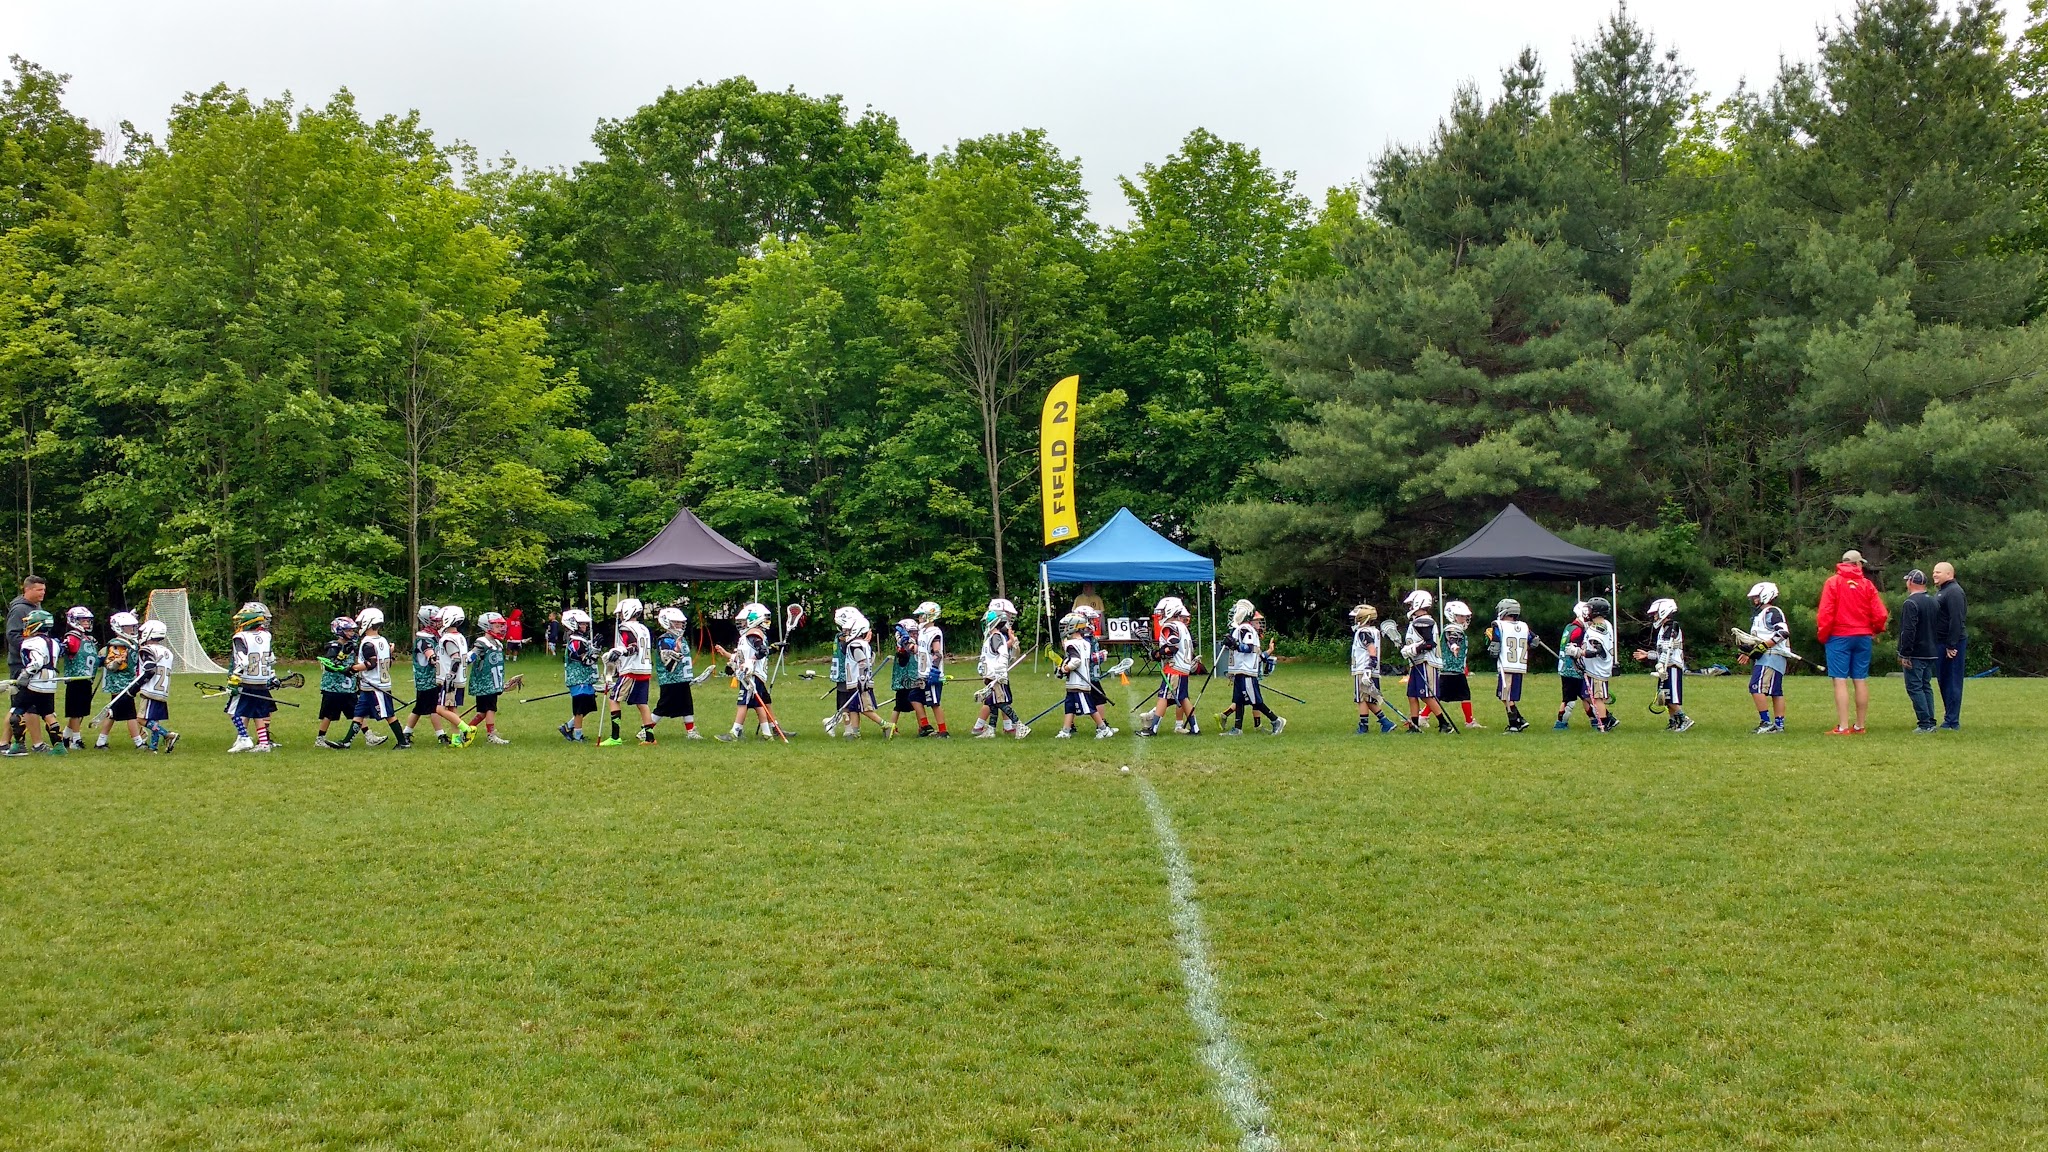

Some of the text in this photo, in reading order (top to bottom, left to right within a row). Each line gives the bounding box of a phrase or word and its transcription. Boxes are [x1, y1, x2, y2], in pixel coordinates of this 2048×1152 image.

[1053, 401, 1069, 423] 2
[1110, 621, 1128, 631] 06
[1506, 637, 1528, 664] 32
[86, 656, 96, 676] 9
